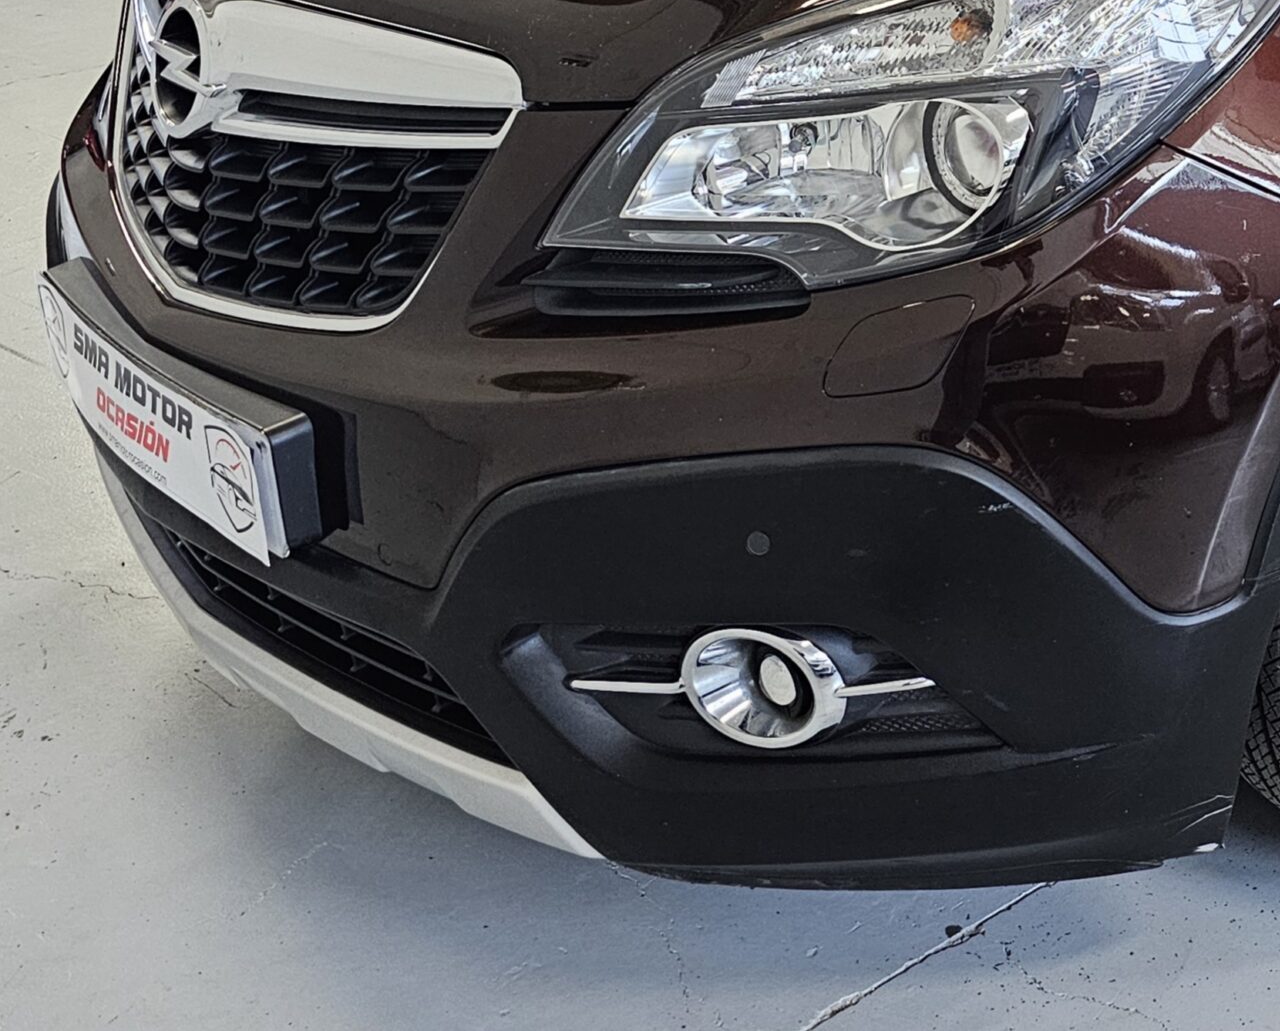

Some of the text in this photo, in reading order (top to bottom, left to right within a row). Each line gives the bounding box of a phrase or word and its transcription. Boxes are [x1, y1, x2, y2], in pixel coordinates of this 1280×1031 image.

[73, 322, 194, 441] SMA MOTOR
[96, 386, 171, 464] OCASIÓN
